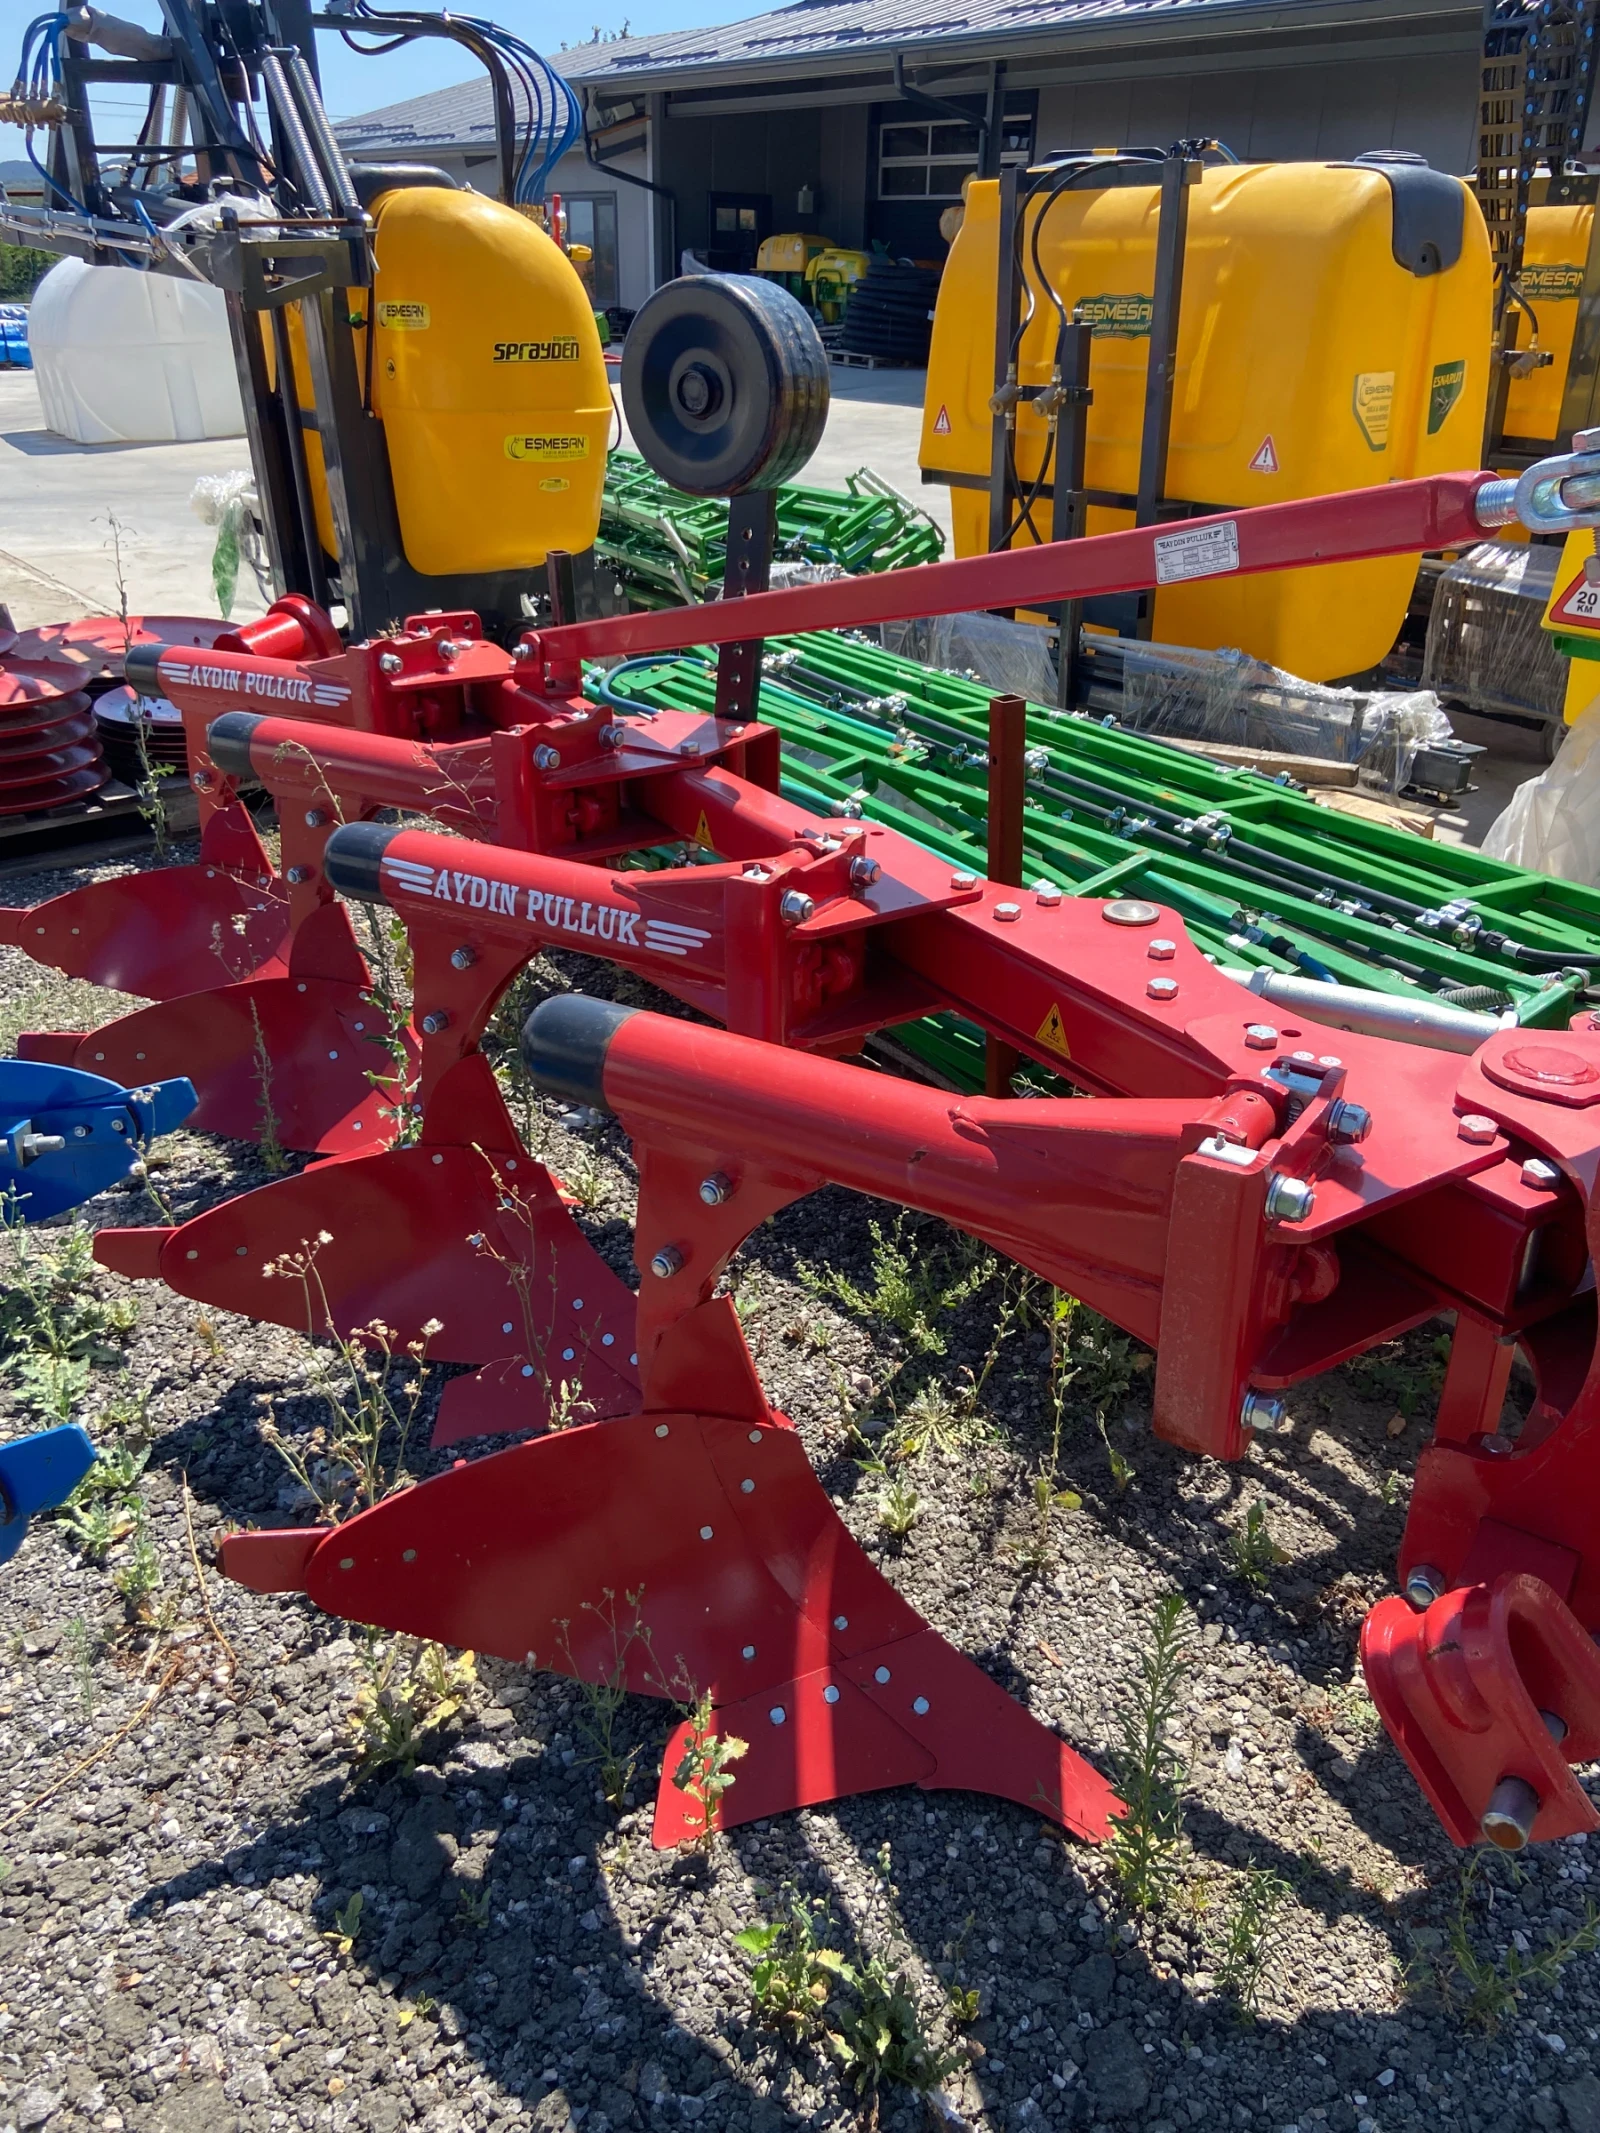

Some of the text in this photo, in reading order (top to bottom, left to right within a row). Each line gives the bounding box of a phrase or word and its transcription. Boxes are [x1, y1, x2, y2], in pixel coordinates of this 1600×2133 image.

[1165, 532, 1213, 548] AYDIN PULLUK
[1577, 591, 1598, 605] 20
[1577, 604, 1593, 614] KM
[190, 665, 312, 703] AYDIN PULLUK
[433, 869, 641, 946] AYDIN PULLUK
